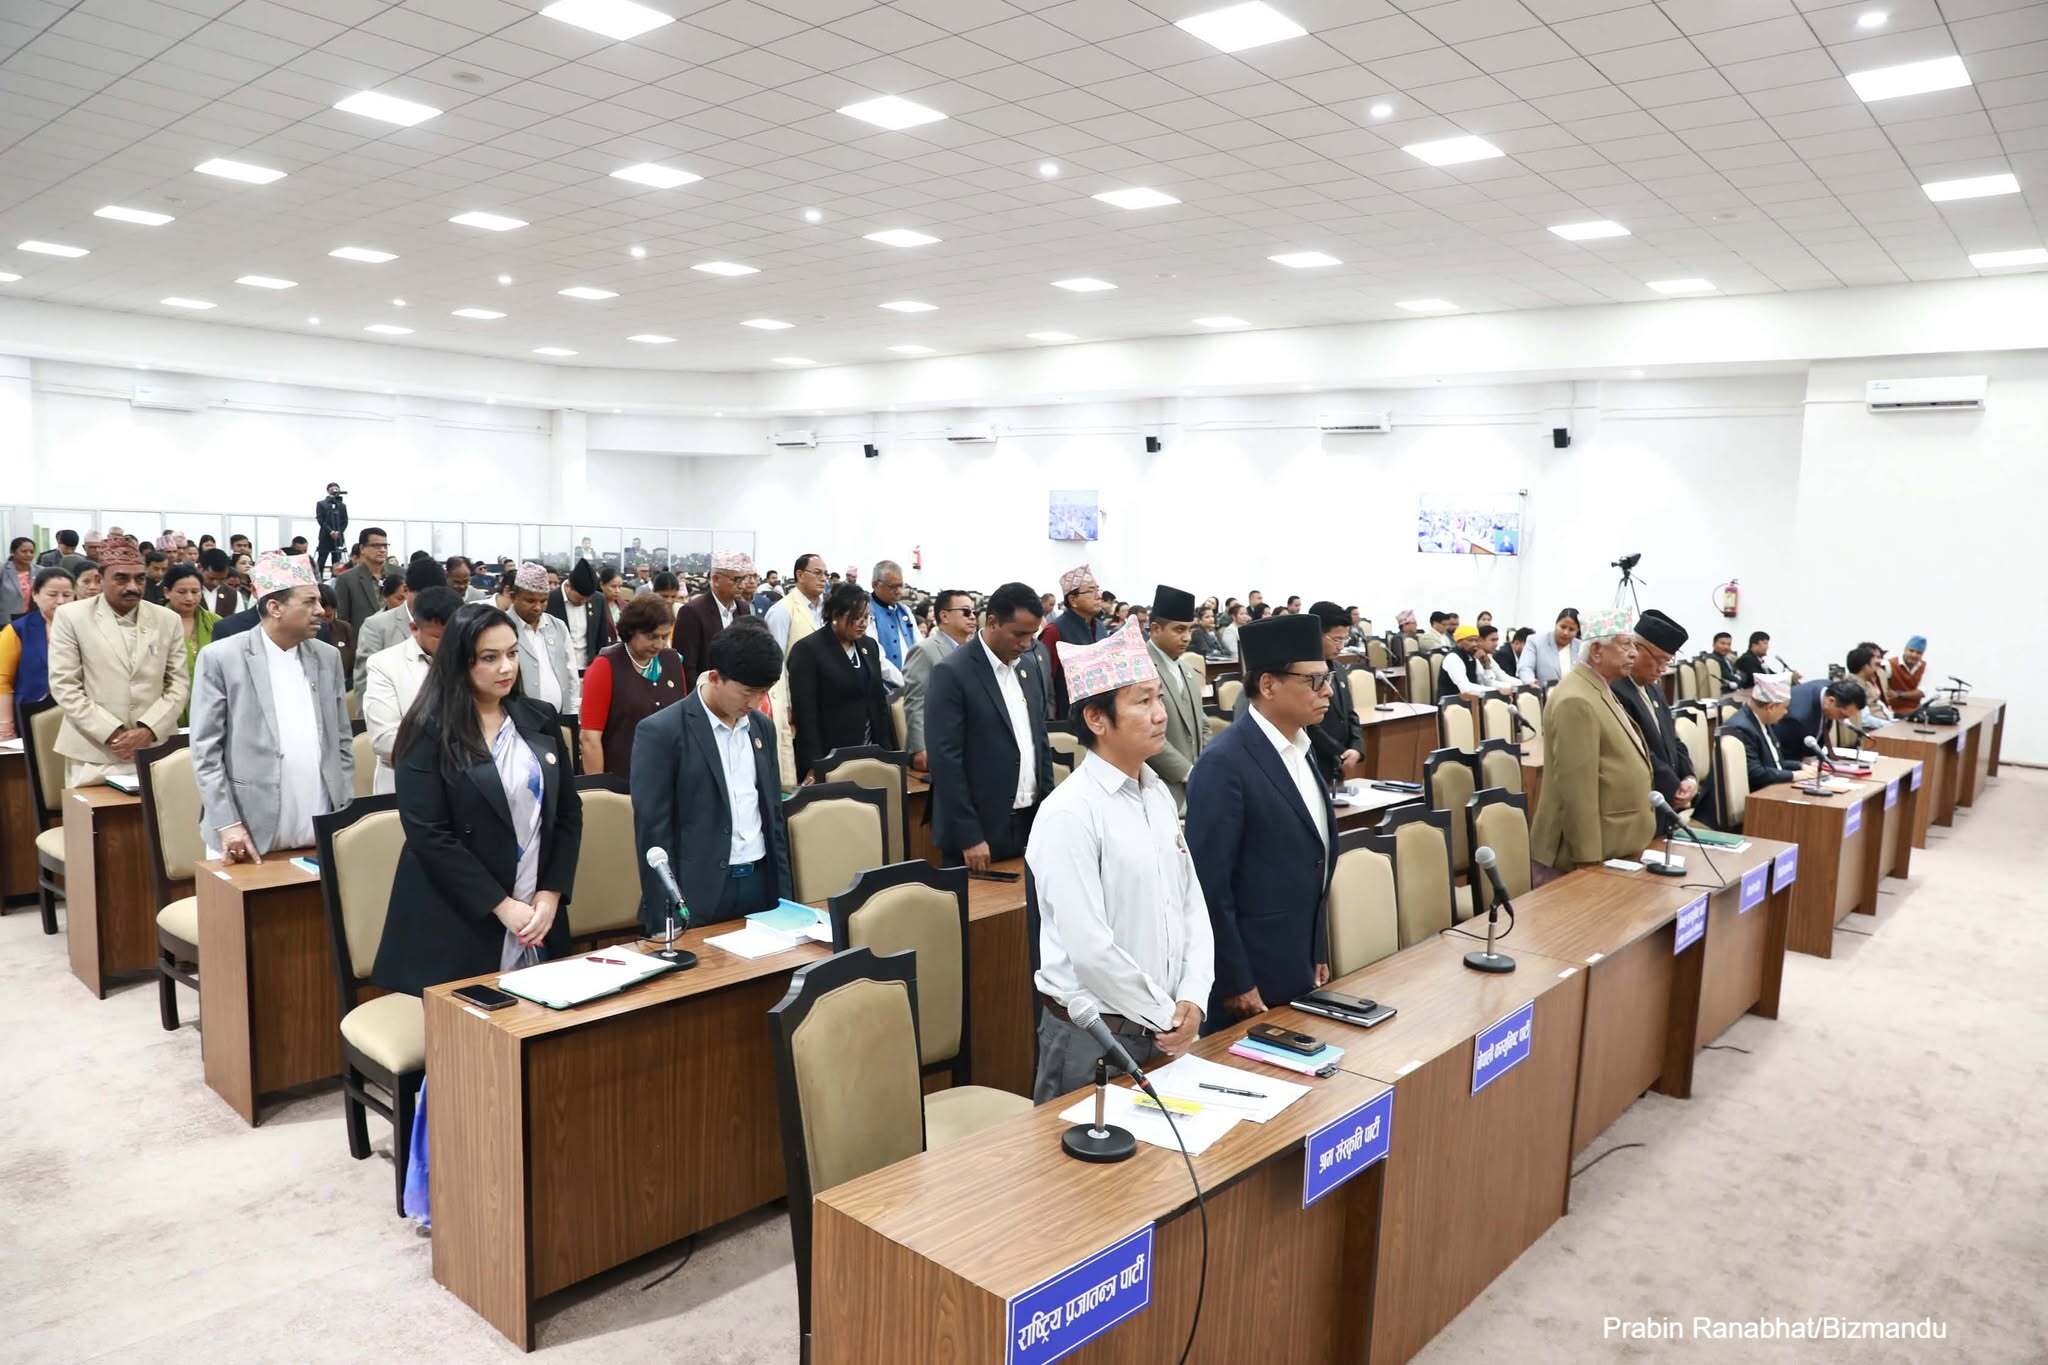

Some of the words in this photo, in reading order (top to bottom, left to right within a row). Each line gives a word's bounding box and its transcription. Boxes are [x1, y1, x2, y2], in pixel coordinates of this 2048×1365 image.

[1319, 1148, 1334, 1173] श्रम
[1335, 1126, 1364, 1162] संस्कृति
[1364, 1115, 1381, 1143] पार्टी
[1017, 1306, 1063, 1351] राष्ट्रिय
[1065, 1274, 1118, 1327] प्रजातन्त्र
[1120, 1253, 1145, 1290] पार्टी
